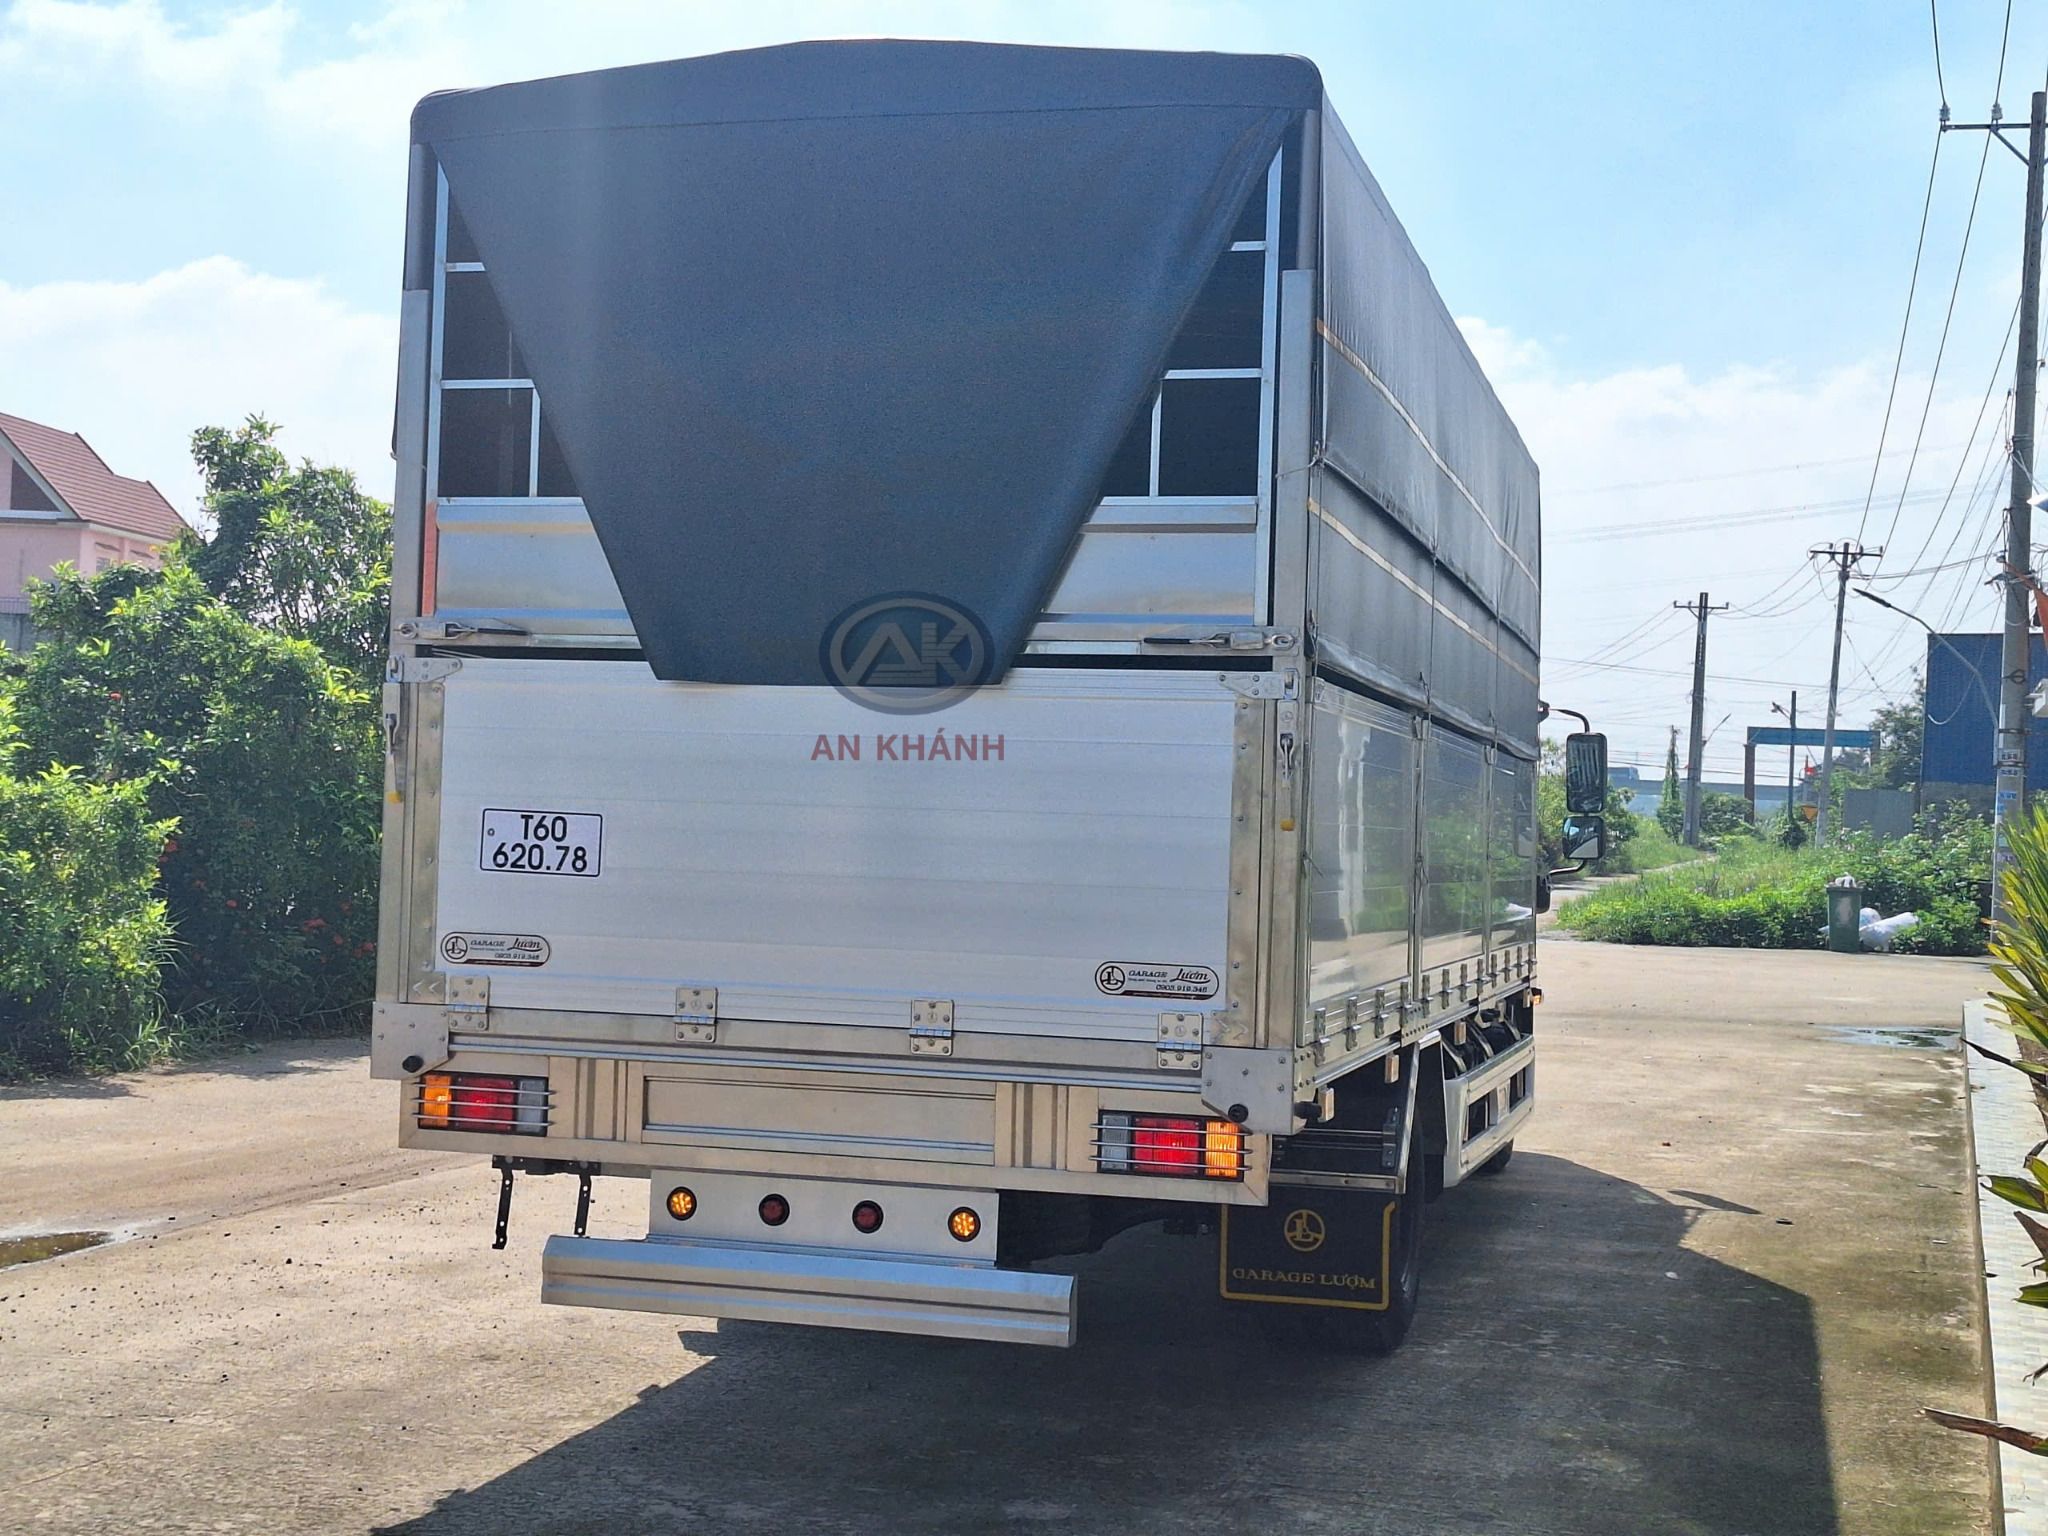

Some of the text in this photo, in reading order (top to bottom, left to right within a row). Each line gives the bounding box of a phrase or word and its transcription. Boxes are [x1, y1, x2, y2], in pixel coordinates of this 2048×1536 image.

[520, 814, 568, 842] T60
[492, 842, 588, 873] 620.78
[470, 939, 506, 948] GARAGE
[1128, 969, 1168, 978] GARAGE
[1232, 1268, 1315, 1285] GARAGE
